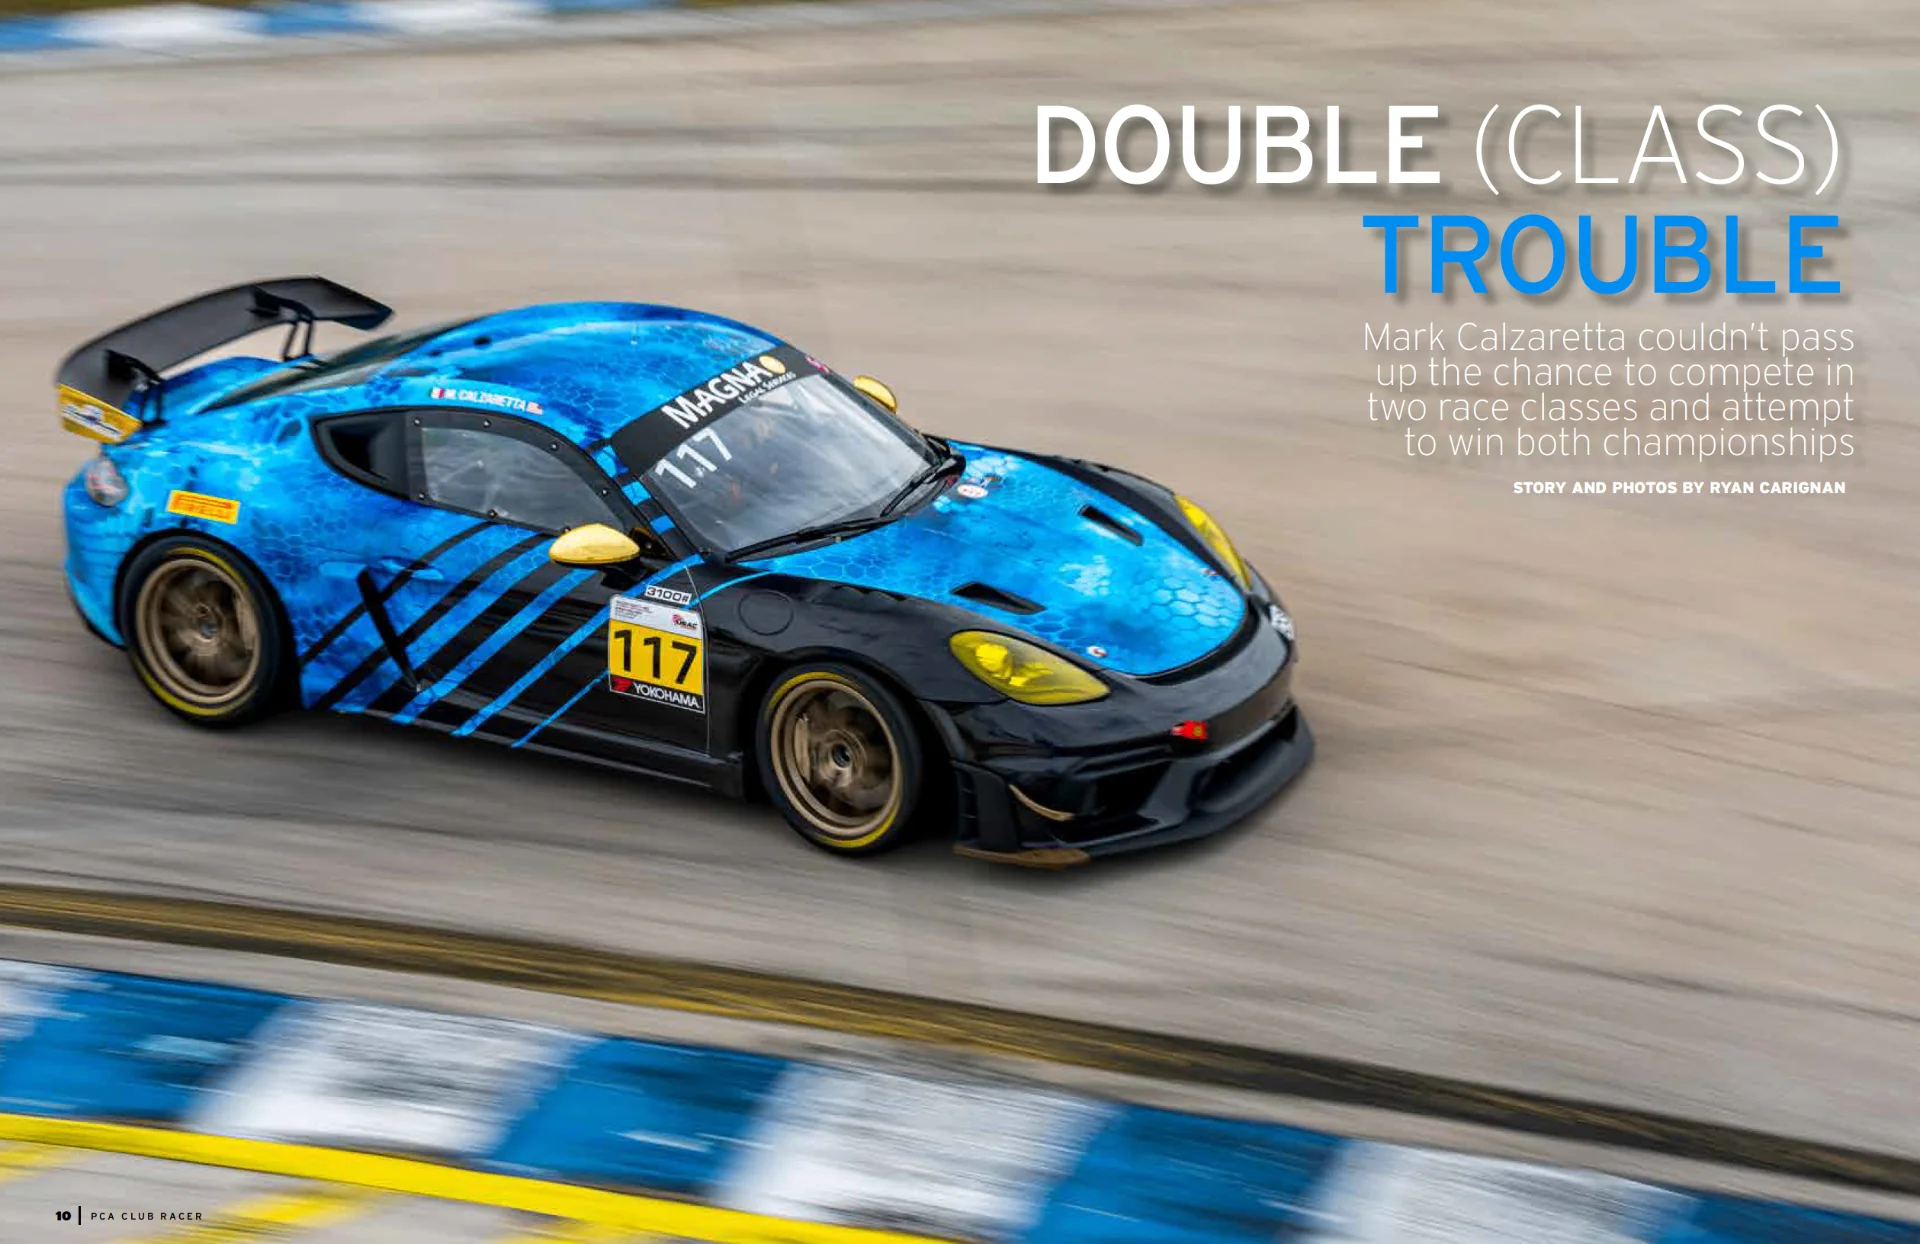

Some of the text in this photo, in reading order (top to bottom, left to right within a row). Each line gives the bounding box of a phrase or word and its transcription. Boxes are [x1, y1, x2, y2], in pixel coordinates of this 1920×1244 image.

[661, 361, 773, 429] MAGNA
[654, 427, 733, 489] 117
[646, 586, 691, 602] 3100#
[614, 629, 697, 685] 117
[633, 681, 701, 709] YOKOHAMA
